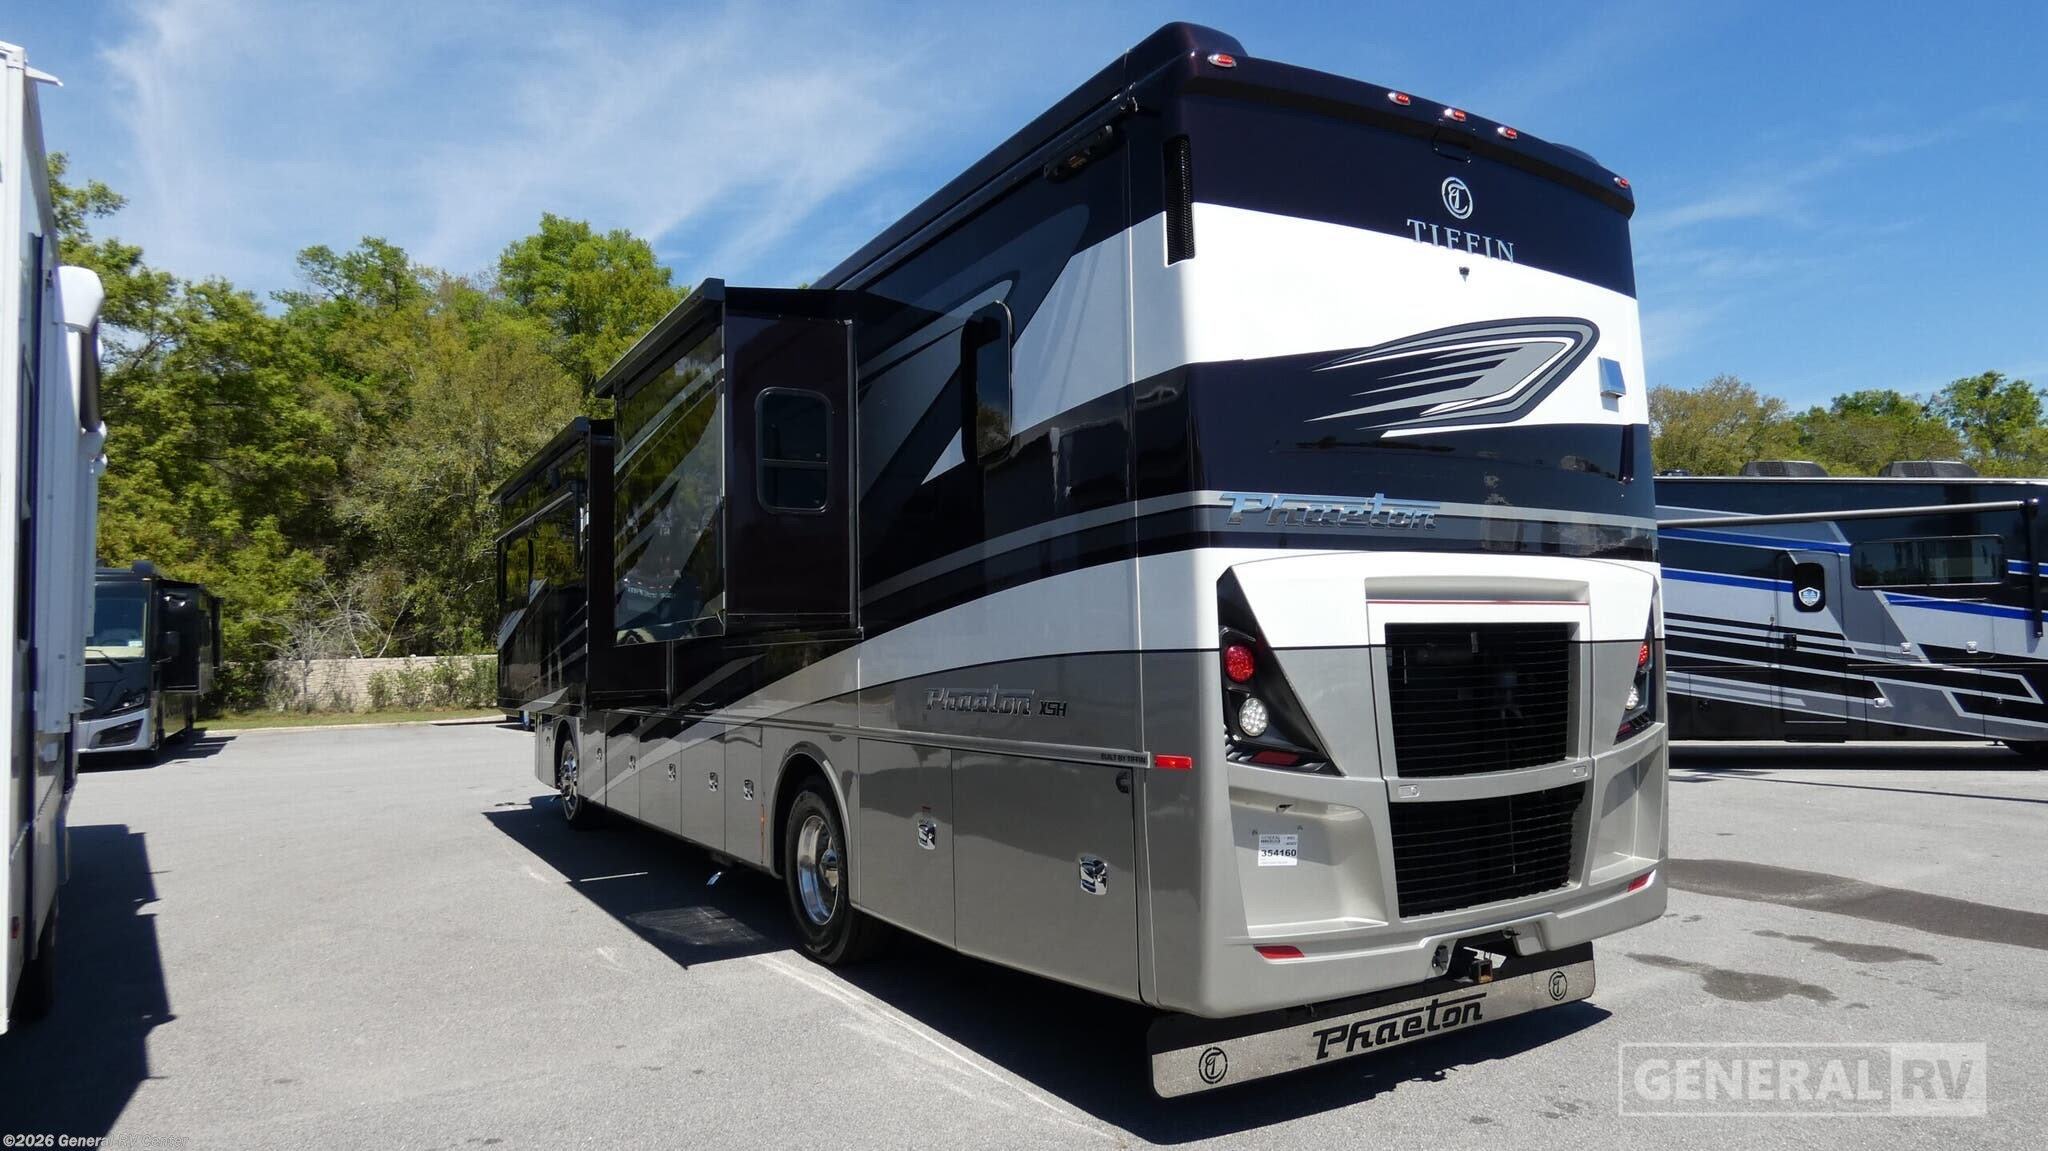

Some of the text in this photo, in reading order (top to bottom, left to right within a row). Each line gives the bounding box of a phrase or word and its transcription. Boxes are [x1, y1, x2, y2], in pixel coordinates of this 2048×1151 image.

[1407, 218, 1514, 264] TIFFIN
[1220, 492, 1441, 530] Phaeton
[925, 684, 1067, 717] Phaeton XSH
[1261, 849, 1297, 857] 354160
[1313, 992, 1487, 1060] Phaeton
